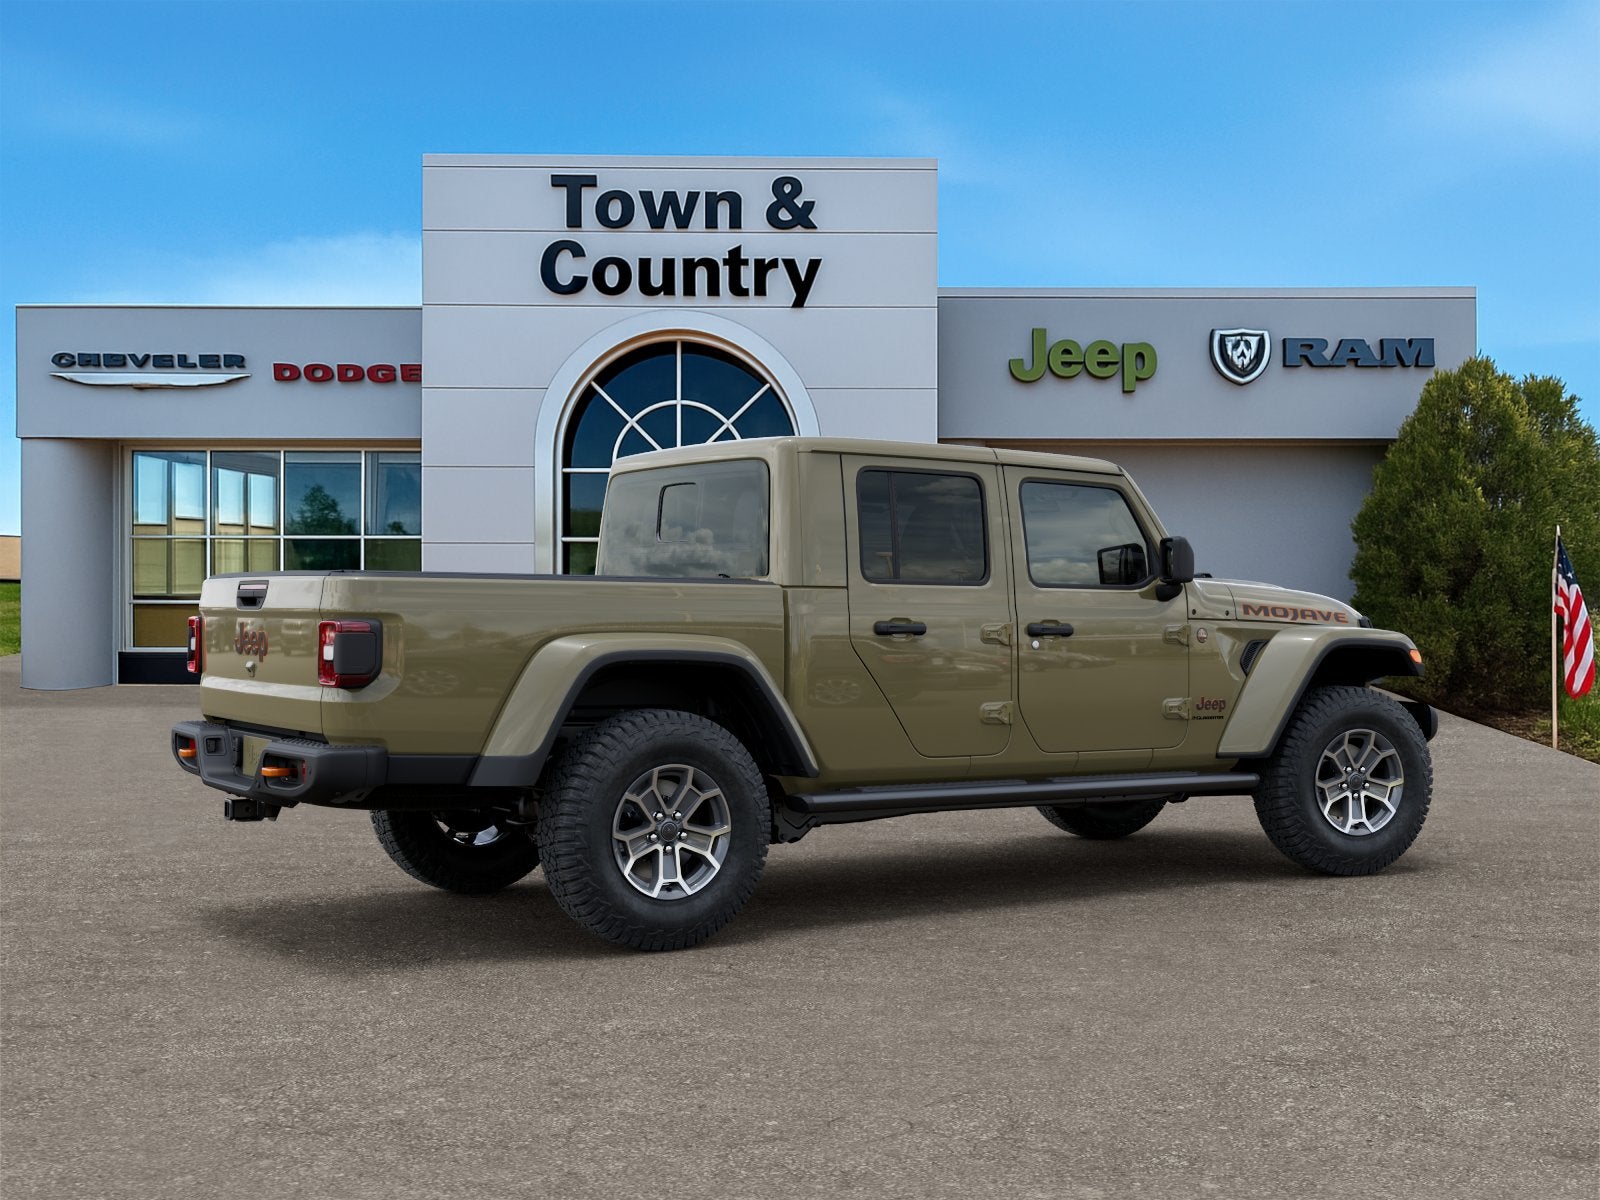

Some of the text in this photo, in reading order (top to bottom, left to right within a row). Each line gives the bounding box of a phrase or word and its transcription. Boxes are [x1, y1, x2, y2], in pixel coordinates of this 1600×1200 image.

[550, 174, 818, 229] Town &
[540, 239, 822, 308] Country
[1009, 328, 1157, 393] Jeep
[1283, 337, 1435, 368] RAM
[273, 363, 421, 382] DODGE
[1242, 603, 1348, 623] MOJAVE
[235, 622, 268, 662] Jeep
[1196, 697, 1226, 712] Jeep
